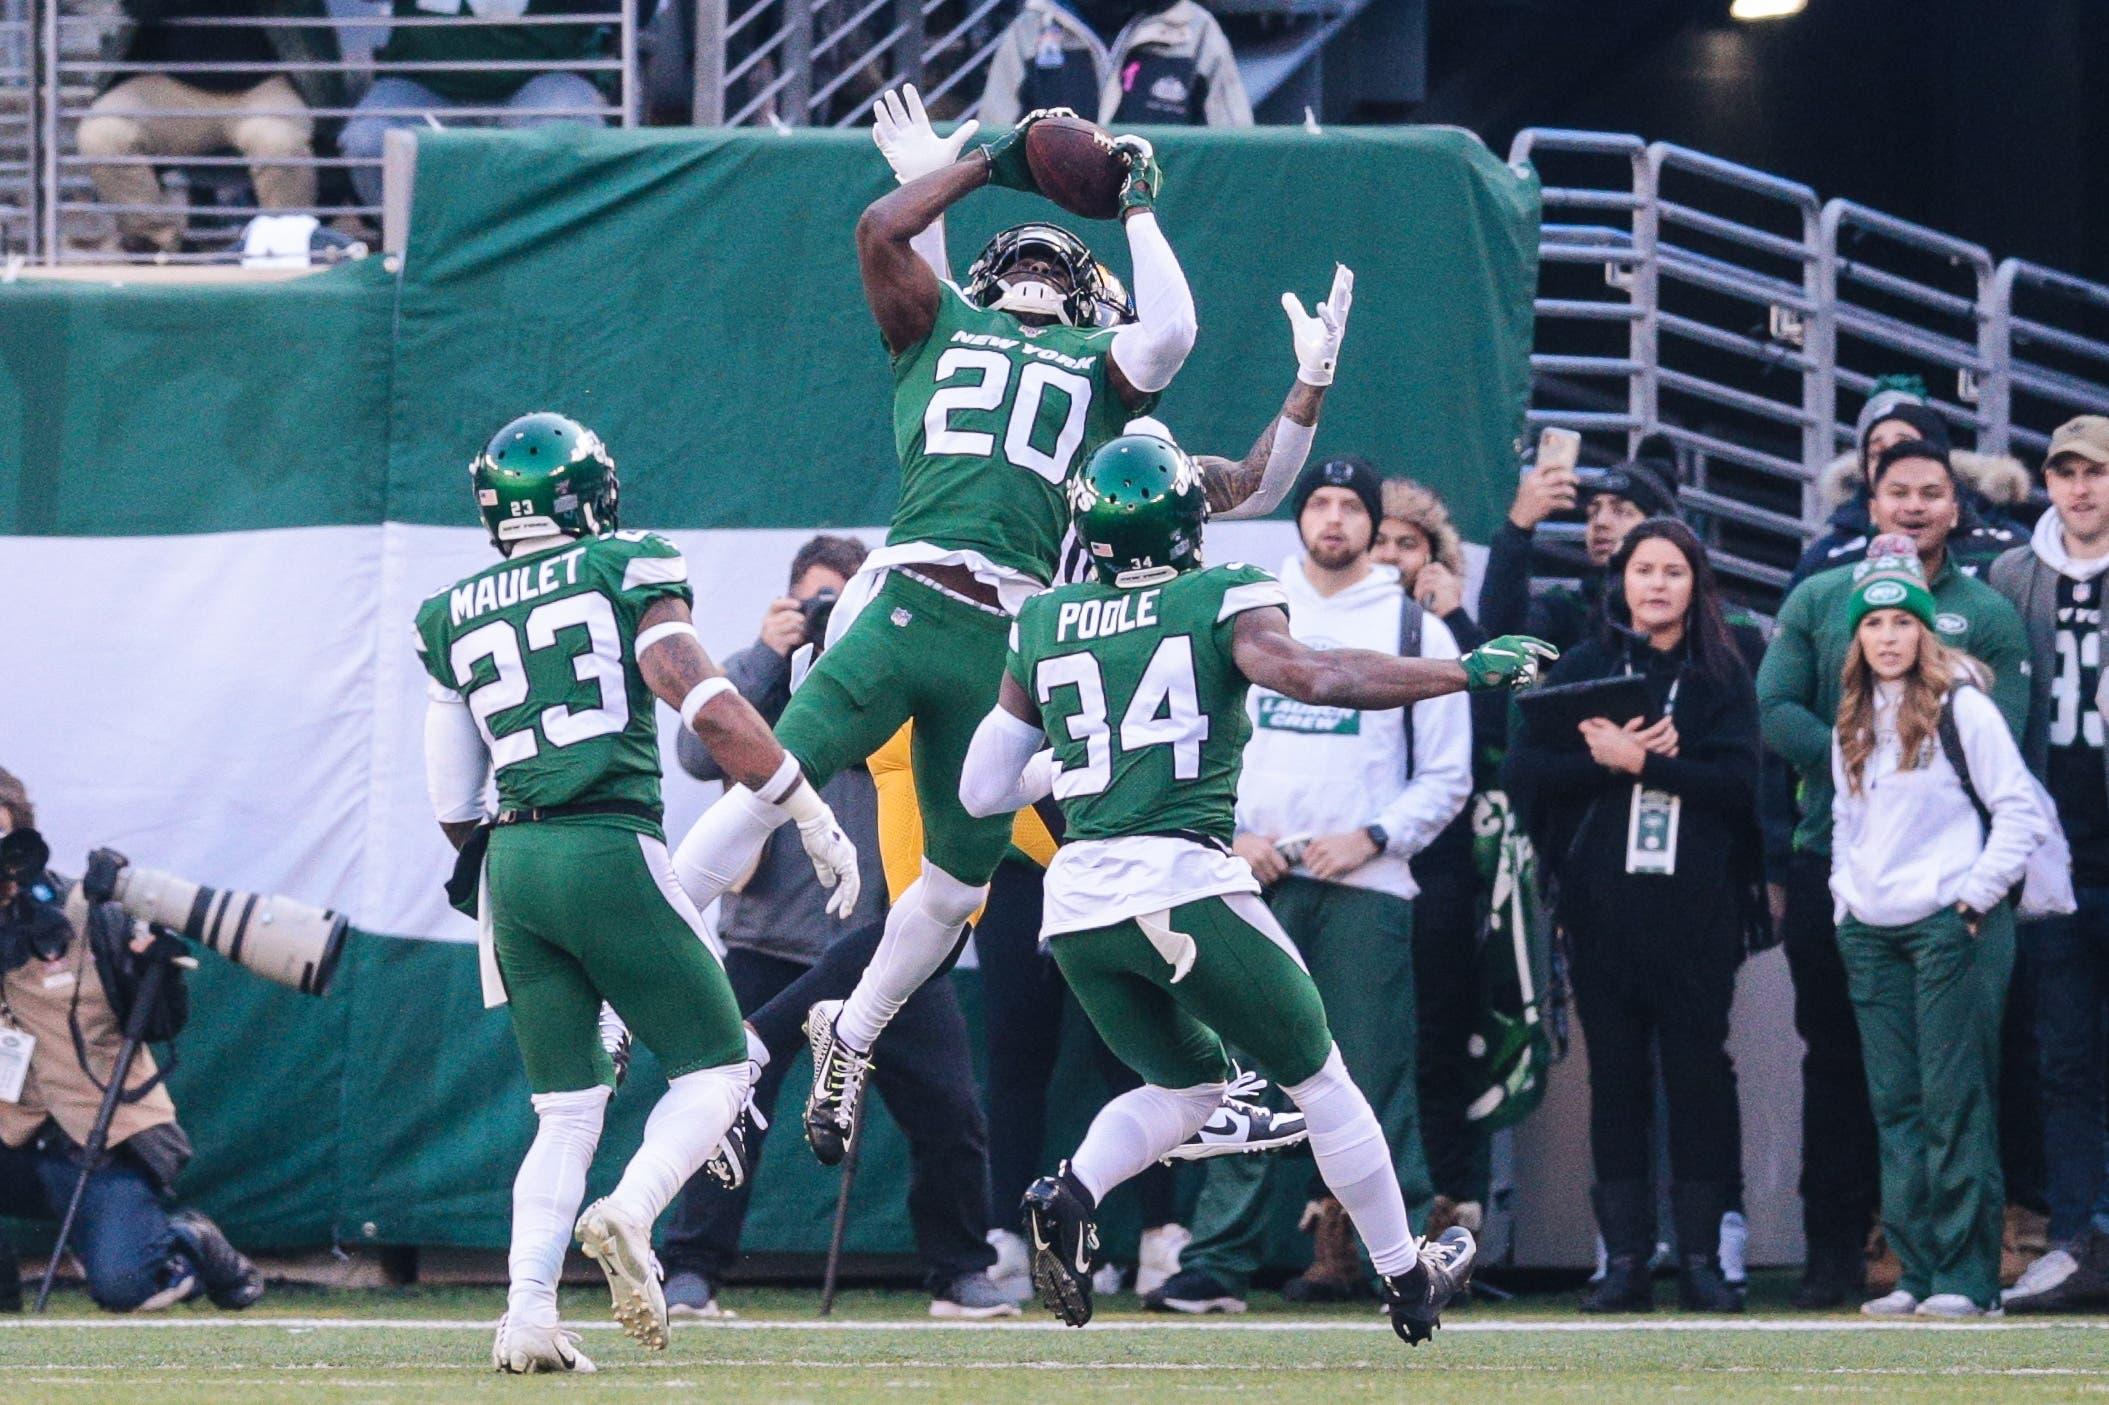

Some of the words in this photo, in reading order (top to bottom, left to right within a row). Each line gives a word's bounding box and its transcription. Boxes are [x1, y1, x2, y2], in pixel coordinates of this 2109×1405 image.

[951, 330, 1019, 349] NEW
[1022, 342, 1096, 370] YORK
[924, 348, 1092, 485] 20
[511, 499, 534, 516] 23
[450, 547, 586, 626] MAULET
[1130, 556, 1152, 569] 34
[1057, 589, 1160, 642] POOLE
[451, 590, 629, 771] 23
[1037, 635, 1208, 800] 34
[1269, 712, 1341, 730] CREW
